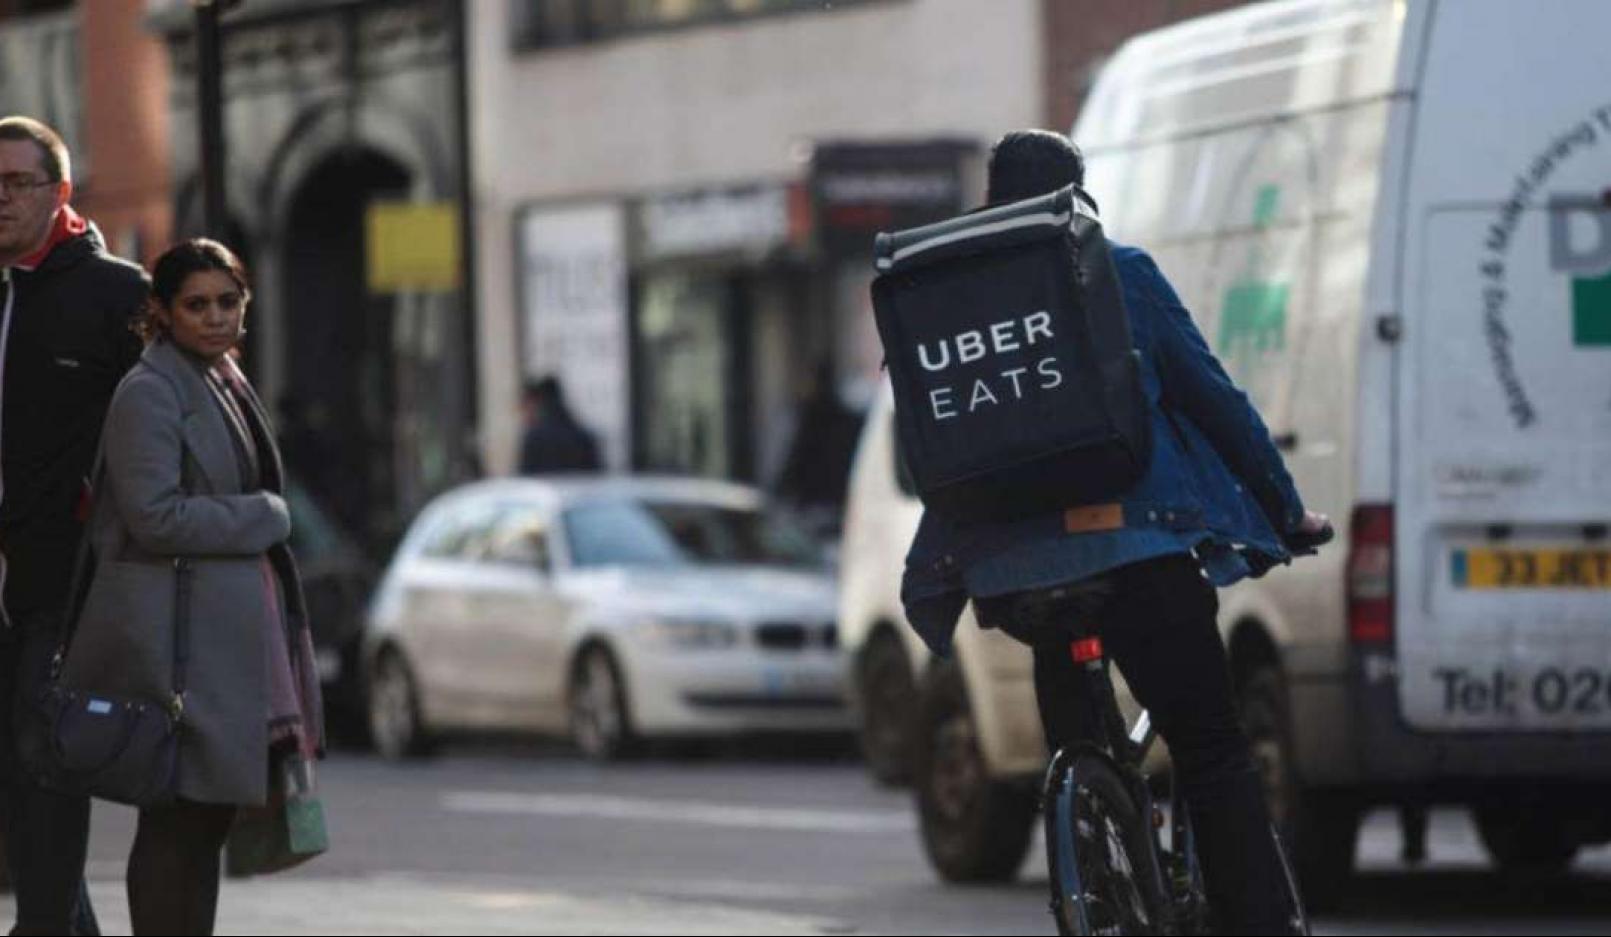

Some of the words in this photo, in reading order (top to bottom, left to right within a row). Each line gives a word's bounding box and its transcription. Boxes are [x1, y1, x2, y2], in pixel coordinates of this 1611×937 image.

[917, 311, 1054, 371] UBER
[929, 357, 1063, 420] EATS
[1533, 666, 1611, 716] 02
